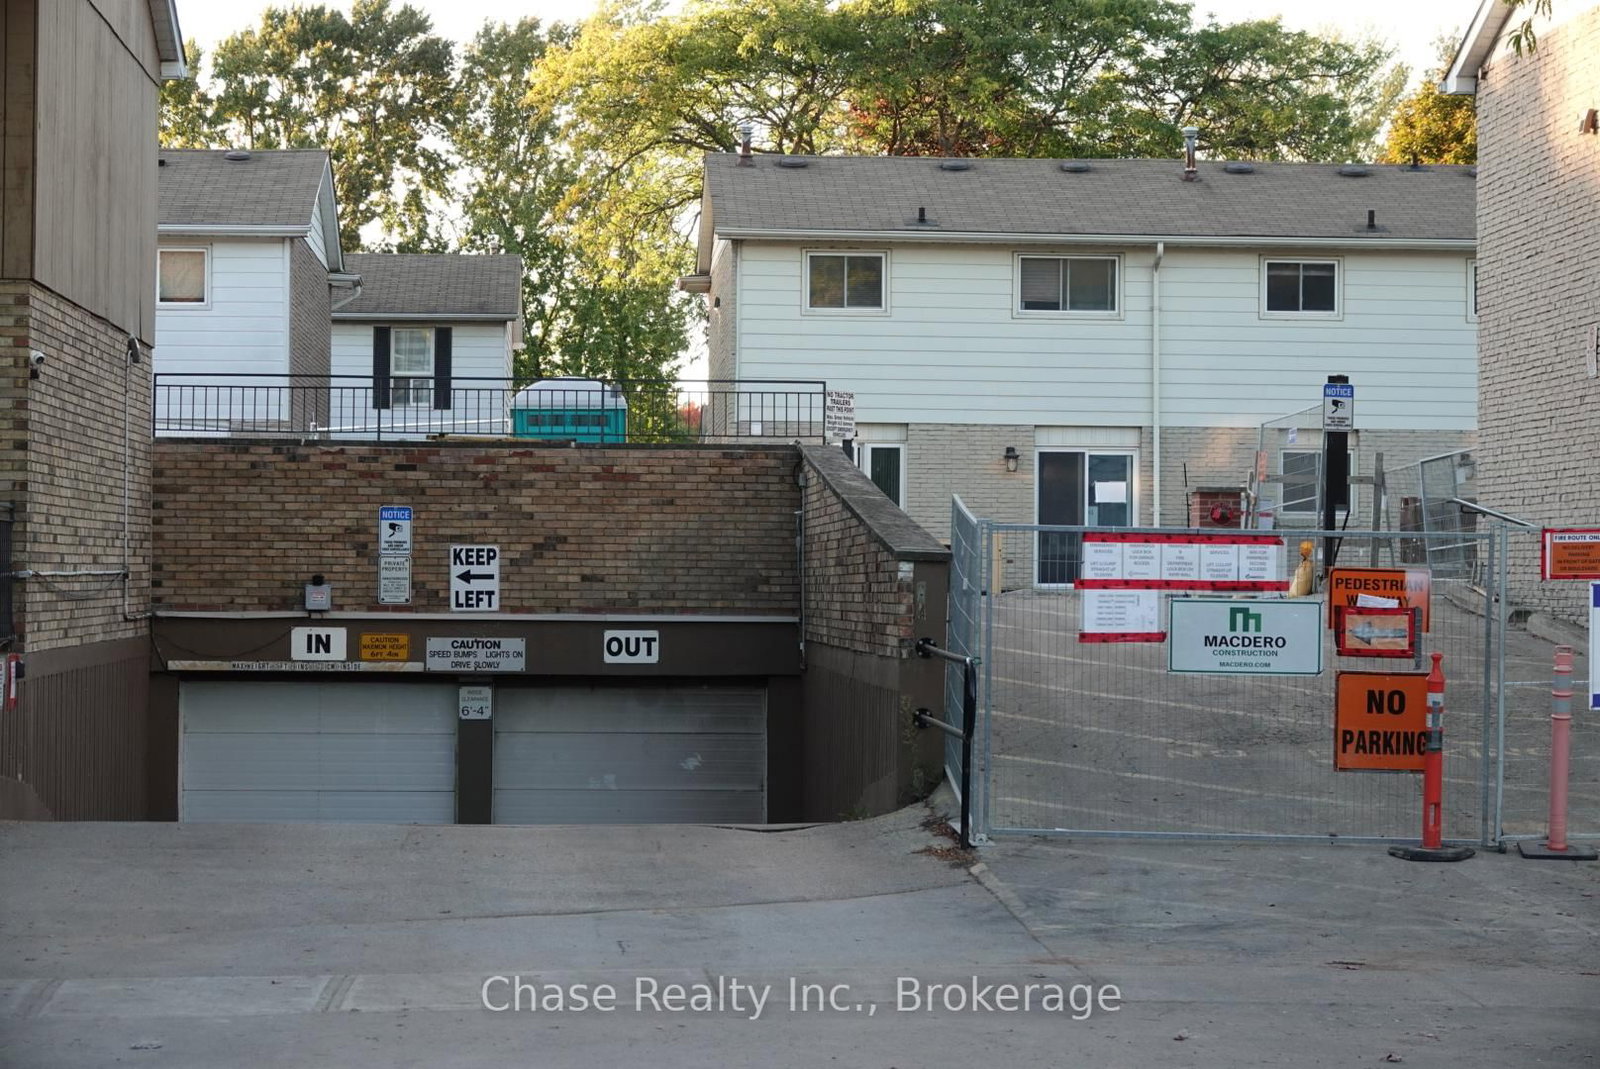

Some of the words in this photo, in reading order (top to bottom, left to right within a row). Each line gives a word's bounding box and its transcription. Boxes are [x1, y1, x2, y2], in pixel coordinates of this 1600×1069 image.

[1326, 388, 1352, 396] NOTICE
[382, 510, 410, 519] NOTICE
[453, 548, 497, 566] KEEP
[1335, 578, 1424, 592] PEDESTRIAN
[455, 590, 495, 608] LEFT
[306, 634, 331, 654] IN
[451, 640, 501, 649] CAUTION
[606, 636, 657, 657] OUT
[1204, 635, 1286, 648] MACDERO
[1366, 690, 1406, 715] NO
[1342, 729, 1427, 755] PARKING
